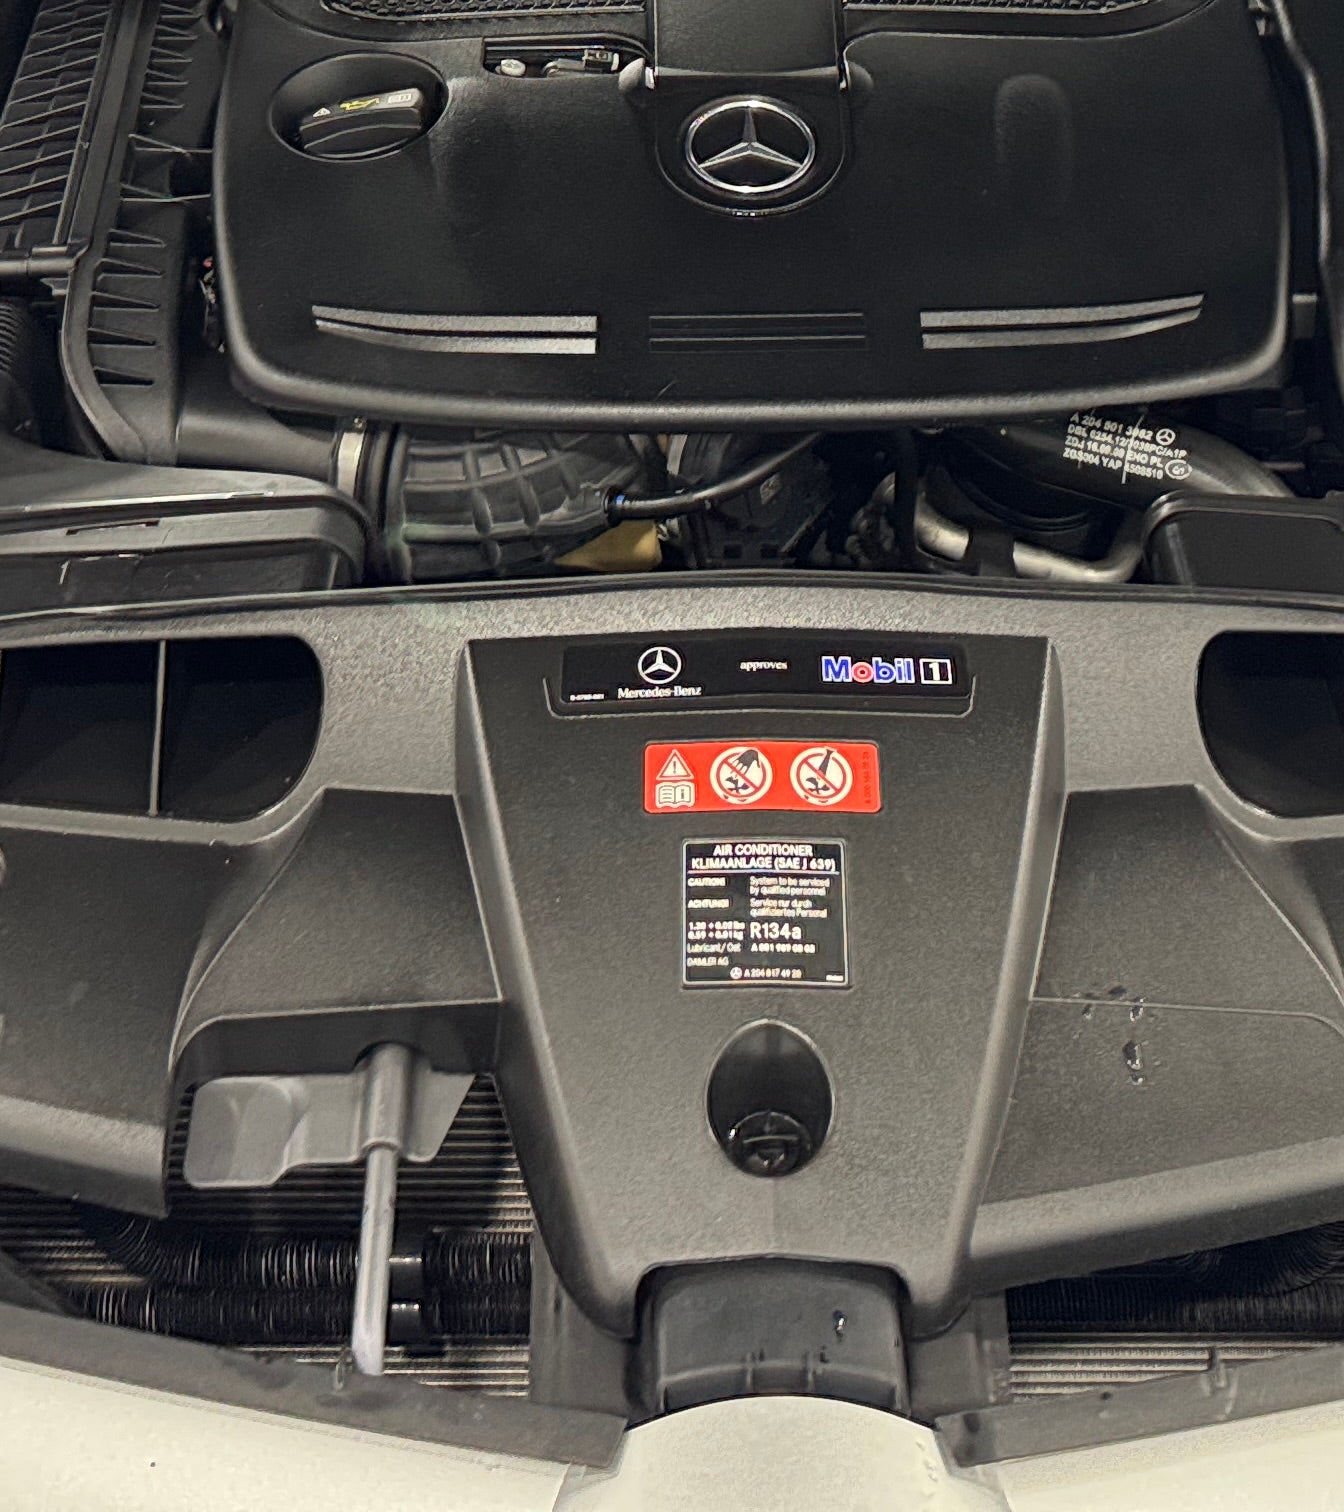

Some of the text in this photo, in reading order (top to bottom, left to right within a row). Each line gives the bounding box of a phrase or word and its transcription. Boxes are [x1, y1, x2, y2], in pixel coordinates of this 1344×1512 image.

[1069, 411, 1080, 424] A
[739, 659, 788, 672] approves
[821, 655, 915, 684] Mobil
[617, 685, 702, 700] Mercedes-Benz
[713, 843, 814, 857] AIR CONDITIONER
[691, 857, 772, 870] KLIMAANLAGE
[774, 858, 800, 871] (SAE
[809, 859, 836, 872] 639)
[750, 876, 830, 888] System to be serviced
[750, 886, 827, 896] by qualified personnel
[750, 898, 813, 908] Service nur durch
[796, 908, 828, 918] Personal
[749, 921, 802, 939] R134a
[717, 957, 729, 966] AG
[744, 969, 751, 978] A
